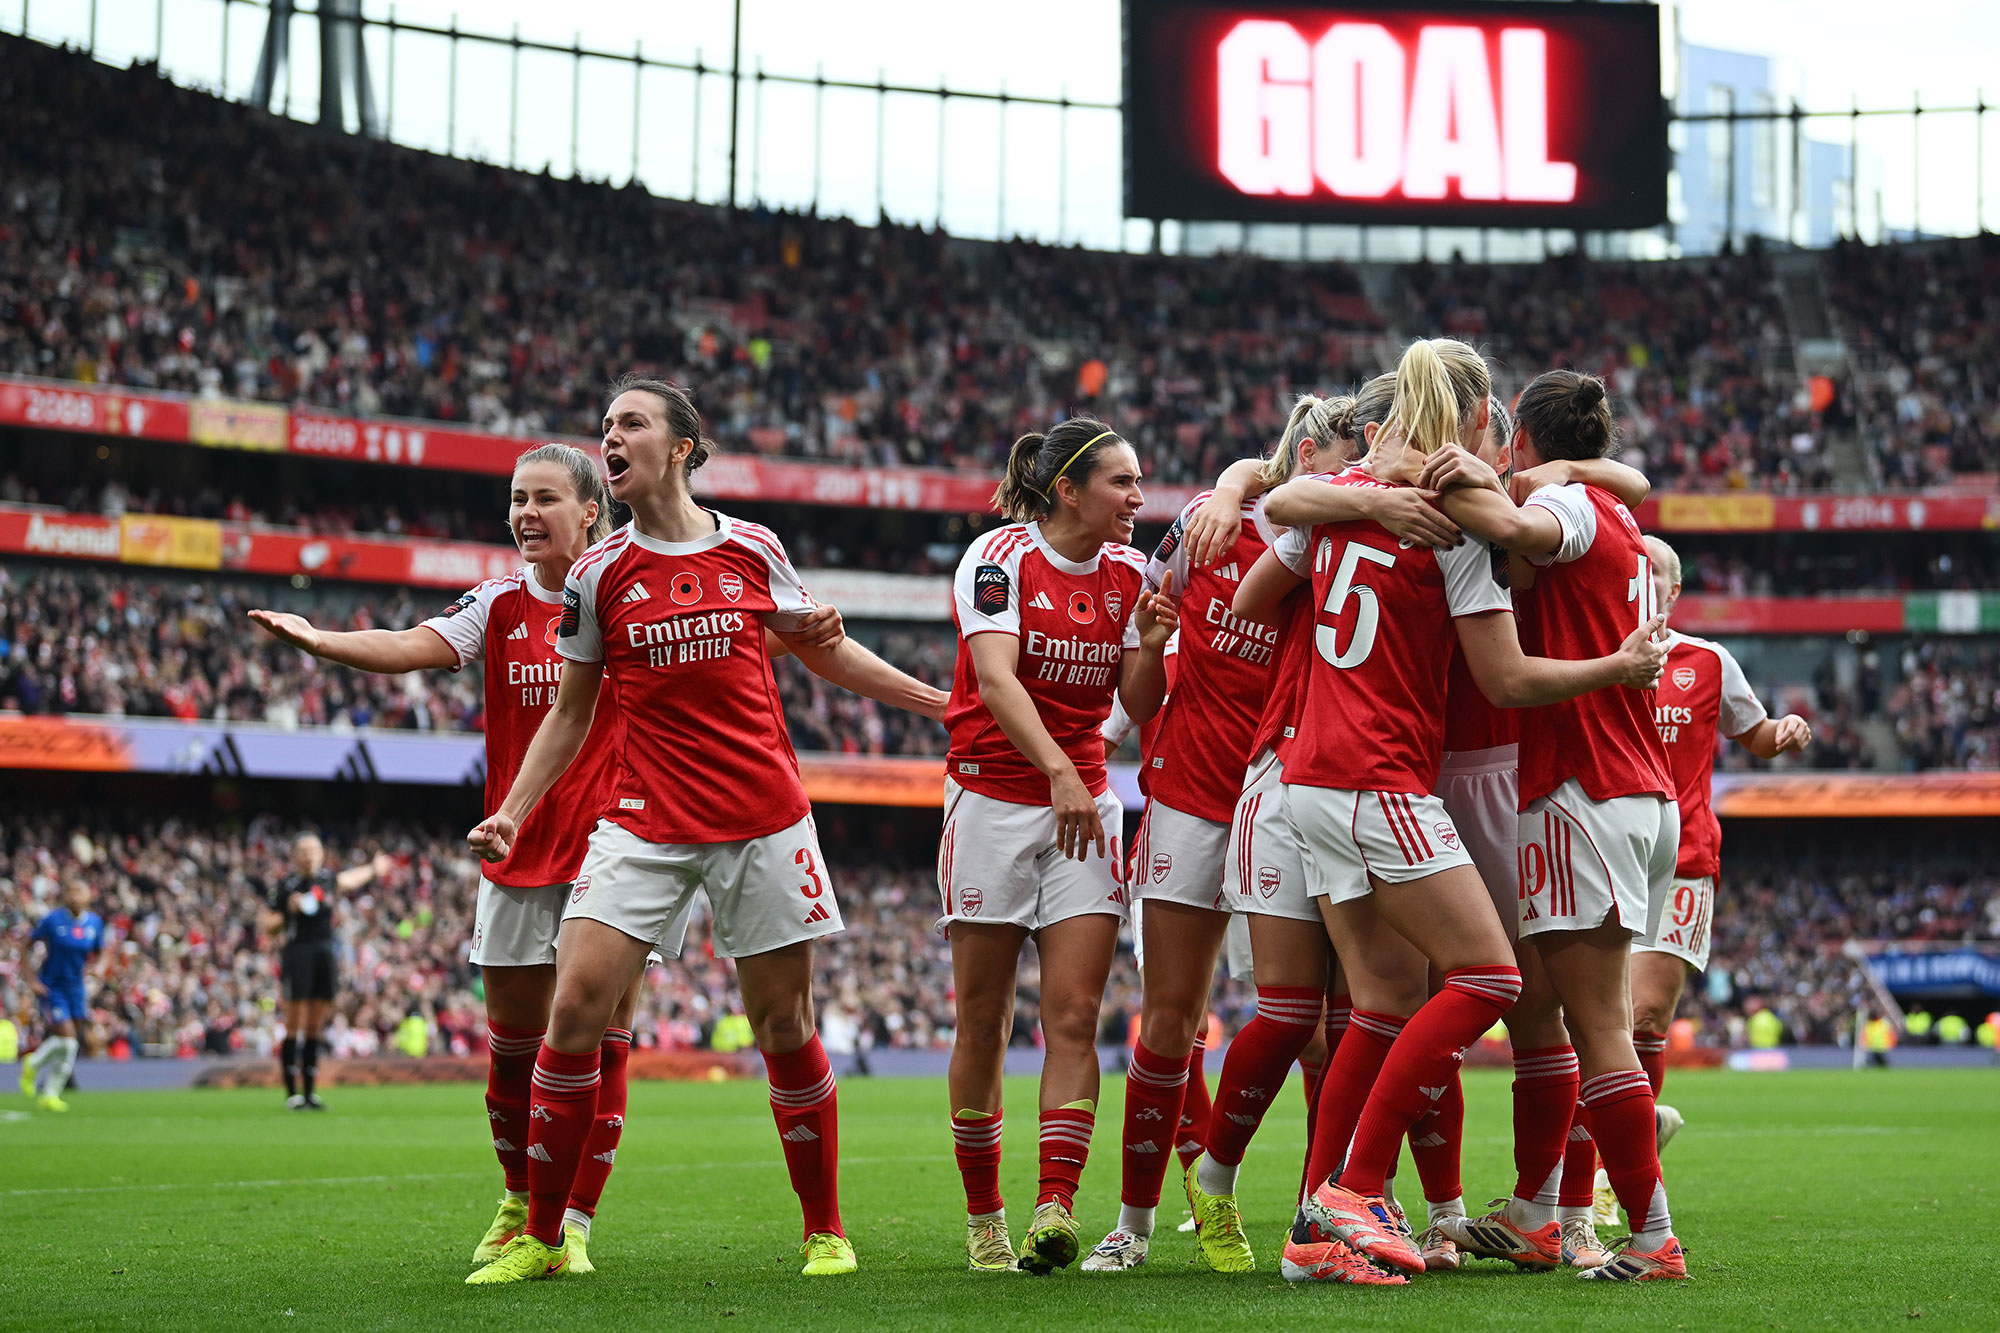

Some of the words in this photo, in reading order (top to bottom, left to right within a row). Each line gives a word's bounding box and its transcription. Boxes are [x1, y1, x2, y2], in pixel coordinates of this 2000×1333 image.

[1216, 20, 1578, 203] GOAL
[25, 513, 120, 556] Arsenal
[627, 611, 744, 648] Emirates
[1026, 630, 1122, 664] Emirates
[1211, 630, 1239, 654] FLY
[650, 645, 676, 668] FLY
[679, 637, 731, 662] BETTER
[508, 658, 564, 685] Emir
[1038, 661, 1064, 683] FLY
[1066, 665, 1111, 686] BETTER
[522, 686, 542, 706] FLY
[795, 847, 823, 899] 3
[1517, 841, 1547, 901] 19
[1672, 886, 1695, 927] 9
